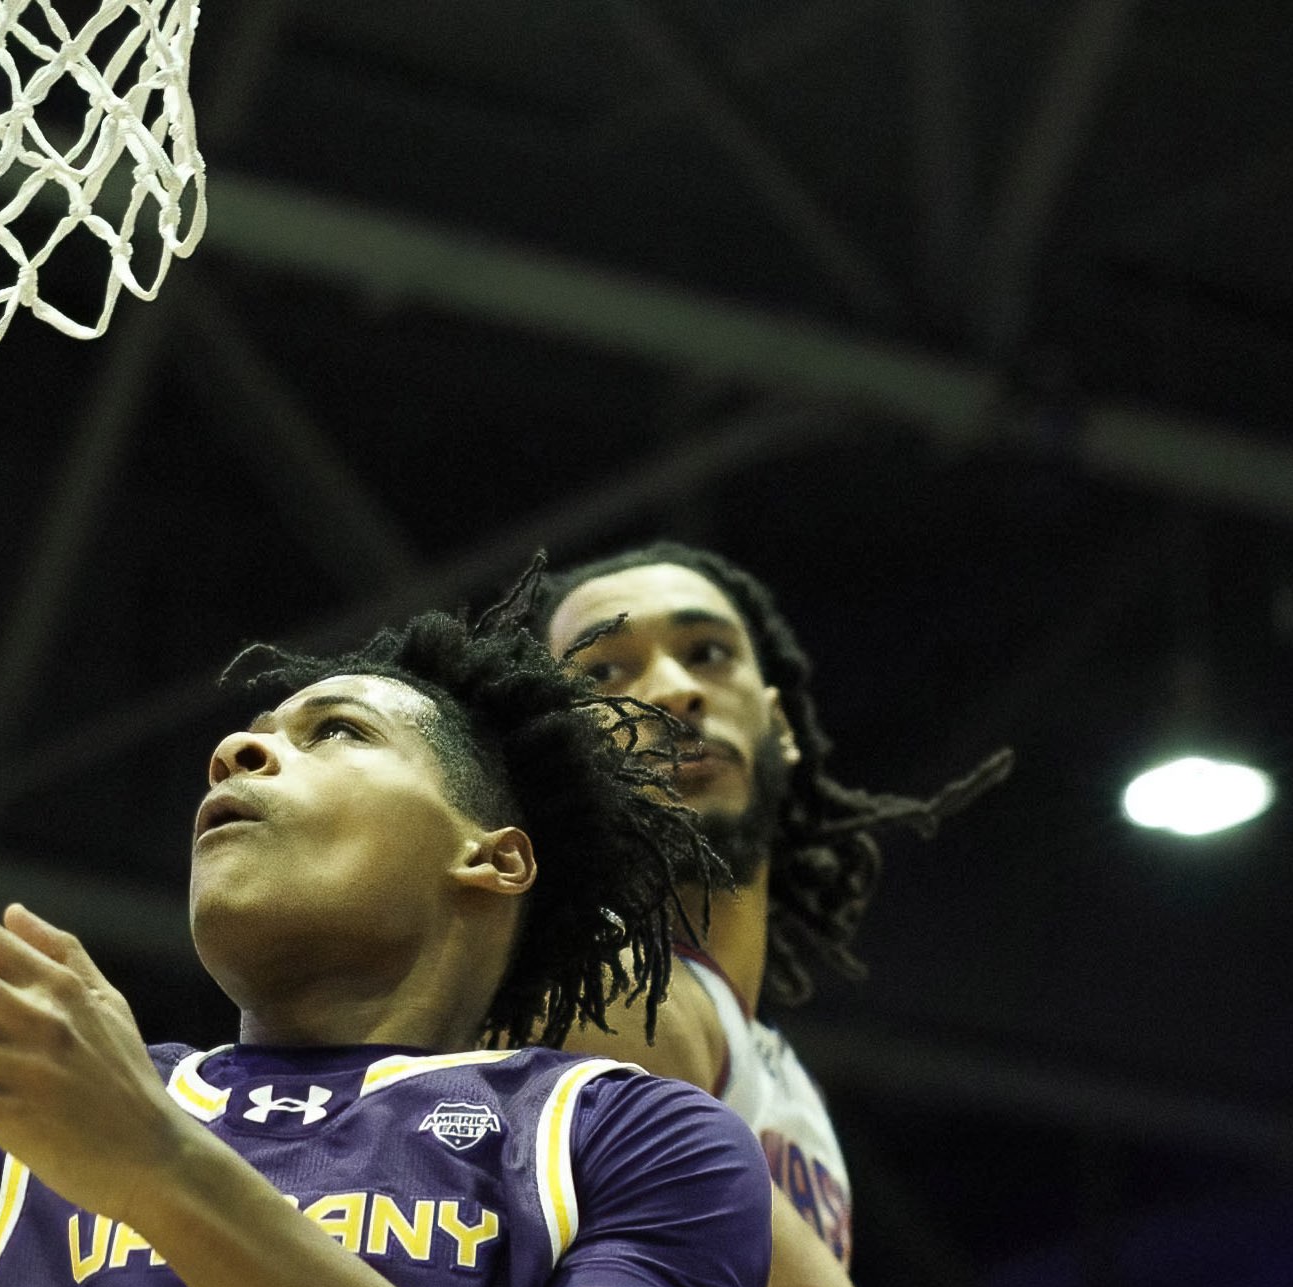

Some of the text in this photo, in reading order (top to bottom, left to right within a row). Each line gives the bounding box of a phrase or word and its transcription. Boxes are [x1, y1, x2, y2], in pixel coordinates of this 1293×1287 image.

[422, 1114, 498, 1131] AMERICA
[439, 1125, 481, 1136] EAST
[69, 1192, 499, 1284] UAANY
